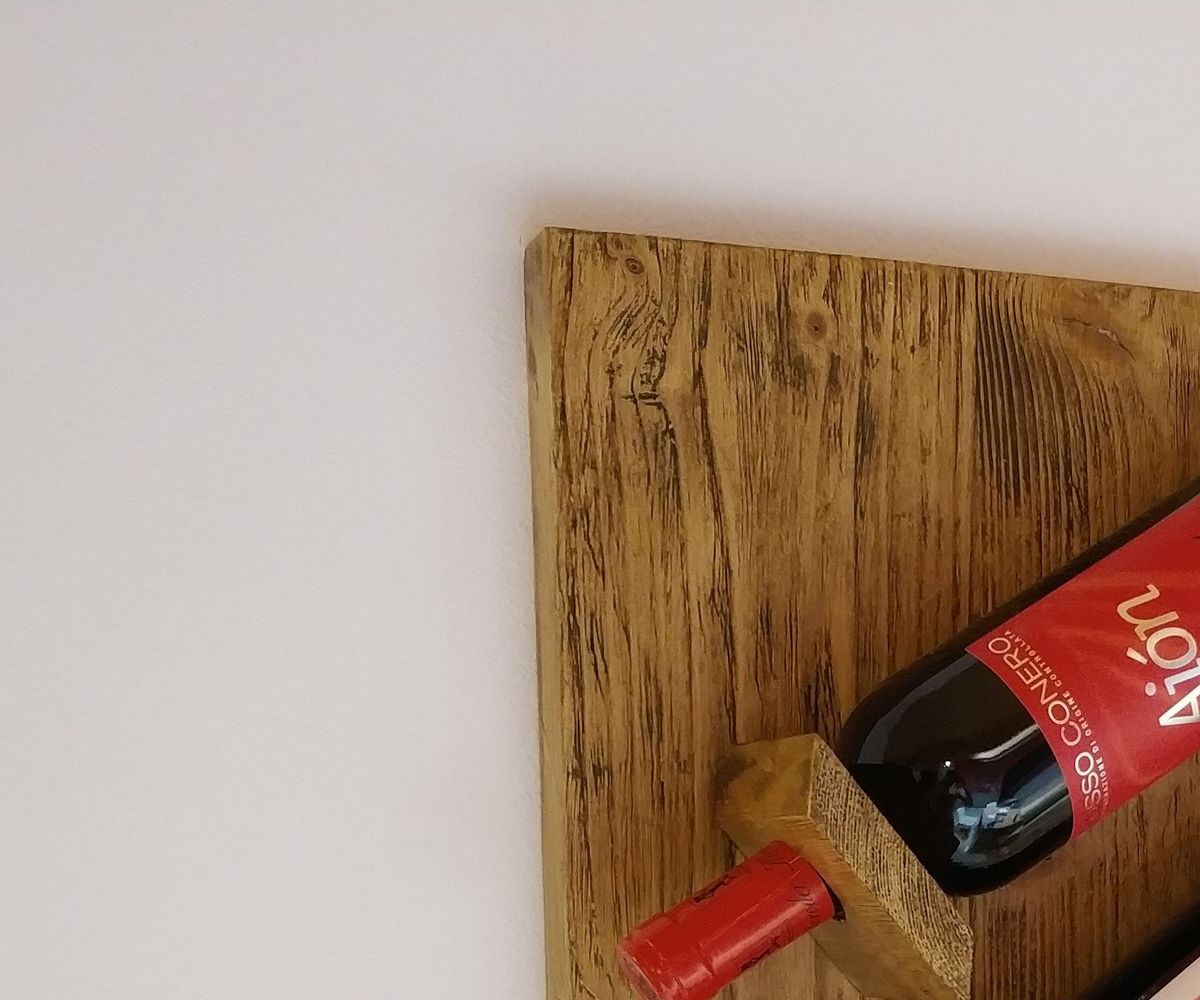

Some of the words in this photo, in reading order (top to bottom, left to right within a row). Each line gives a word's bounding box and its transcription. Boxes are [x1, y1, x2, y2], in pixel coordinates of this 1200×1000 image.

[1004, 630, 1062, 688] CONTROLLATA
[988, 637, 1081, 746] CONERO
[1062, 690, 1092, 736] ORIGINE
[1090, 740, 1099, 754] DI
